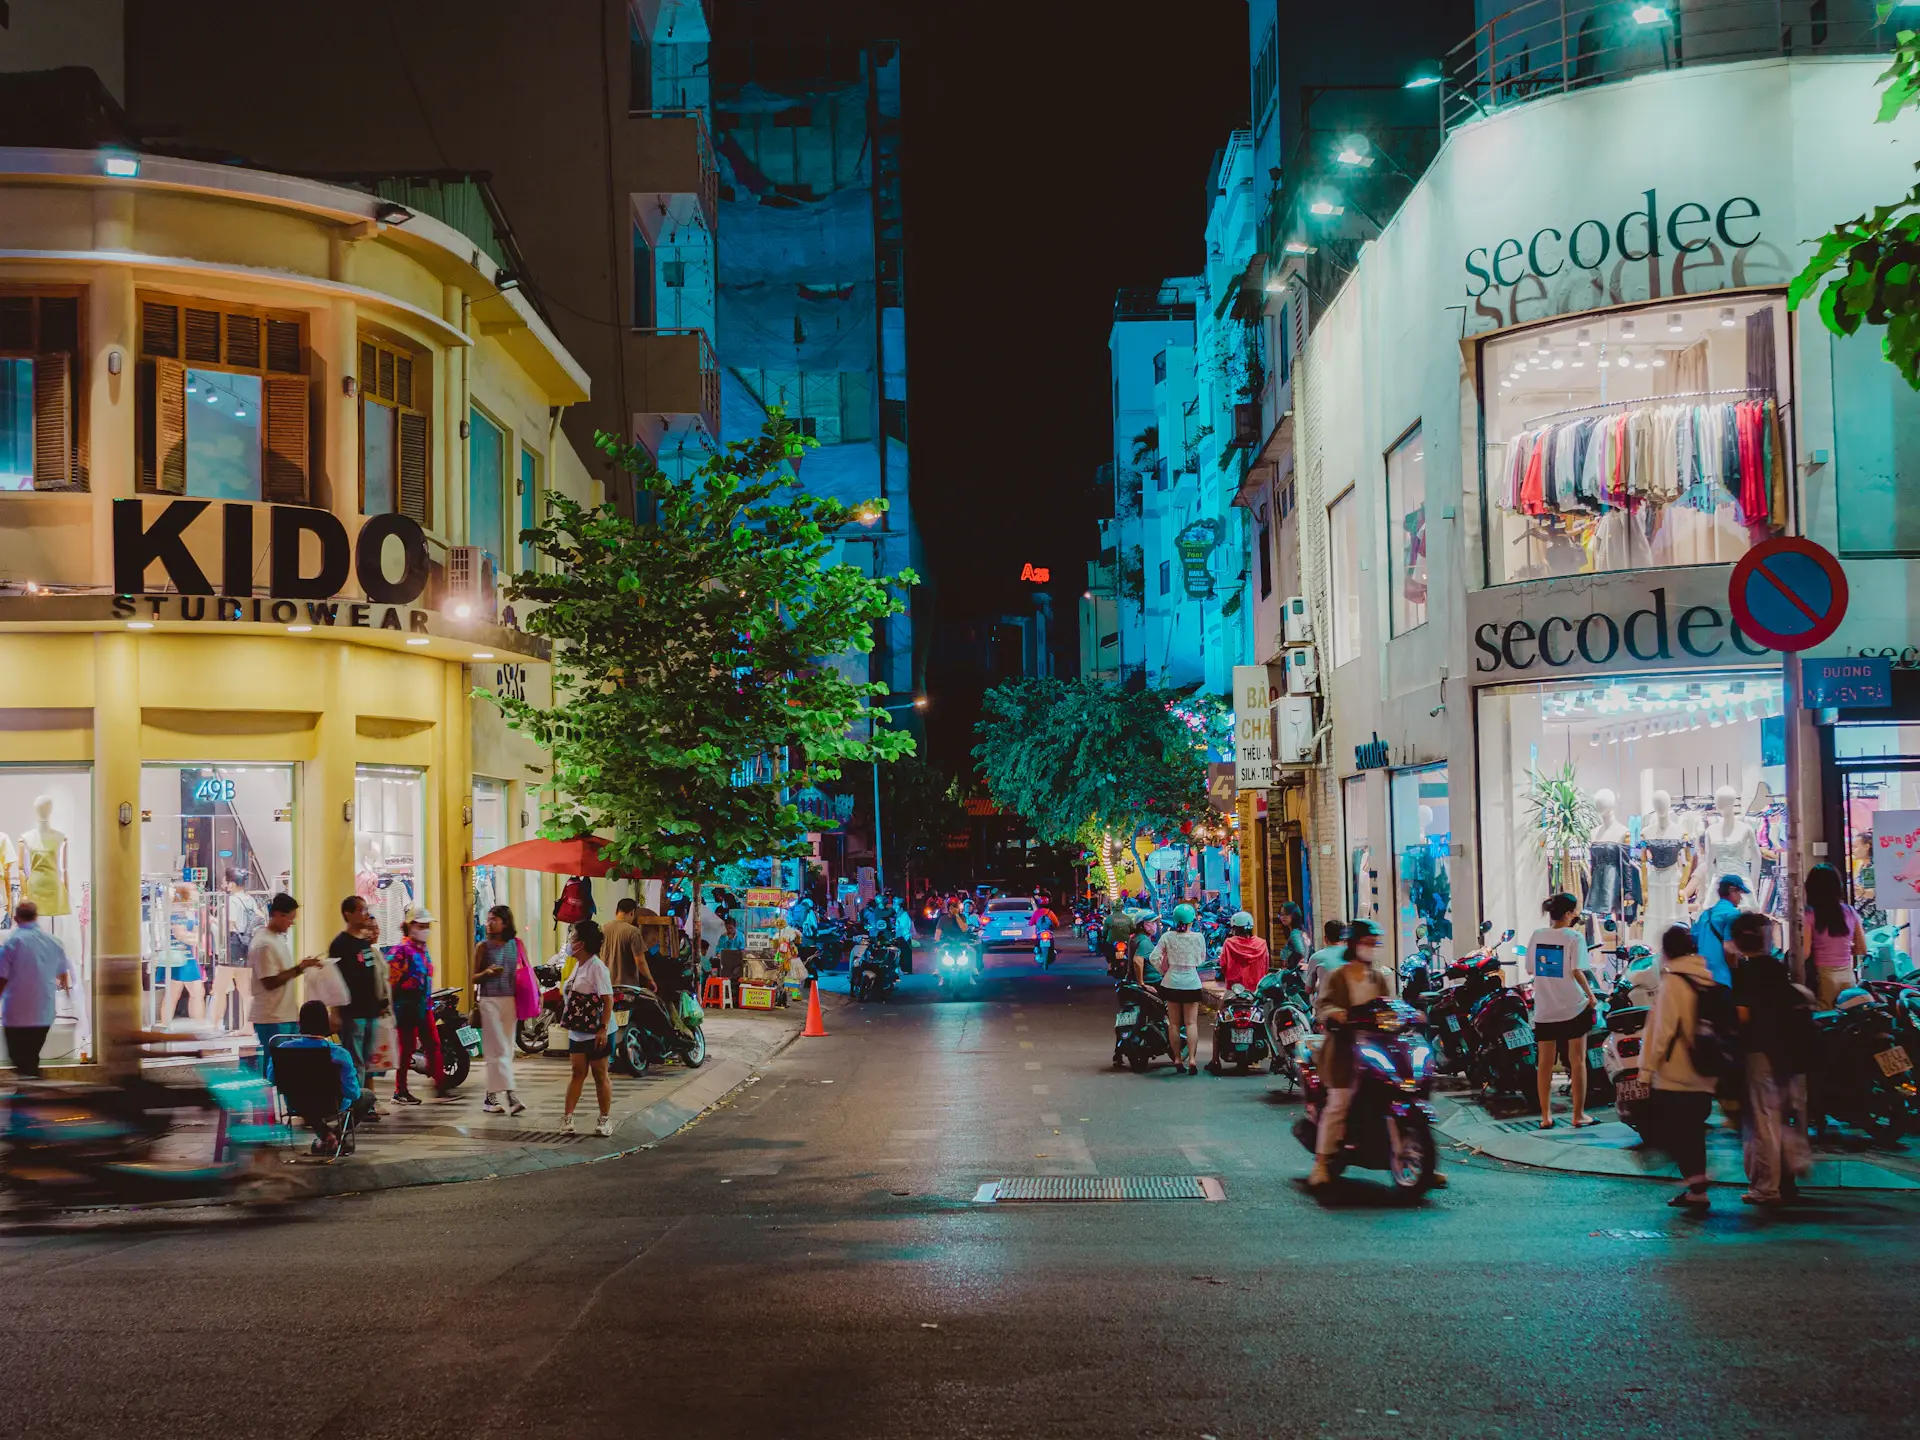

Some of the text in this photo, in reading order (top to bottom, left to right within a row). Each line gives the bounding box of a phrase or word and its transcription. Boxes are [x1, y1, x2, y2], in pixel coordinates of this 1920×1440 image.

[1465, 188, 1762, 298] secodee
[113, 499, 430, 604] KIDO
[111, 595, 430, 635] STUDIOWEAR
[196, 779, 236, 801] 49B
[1241, 768, 1256, 781] SILK
